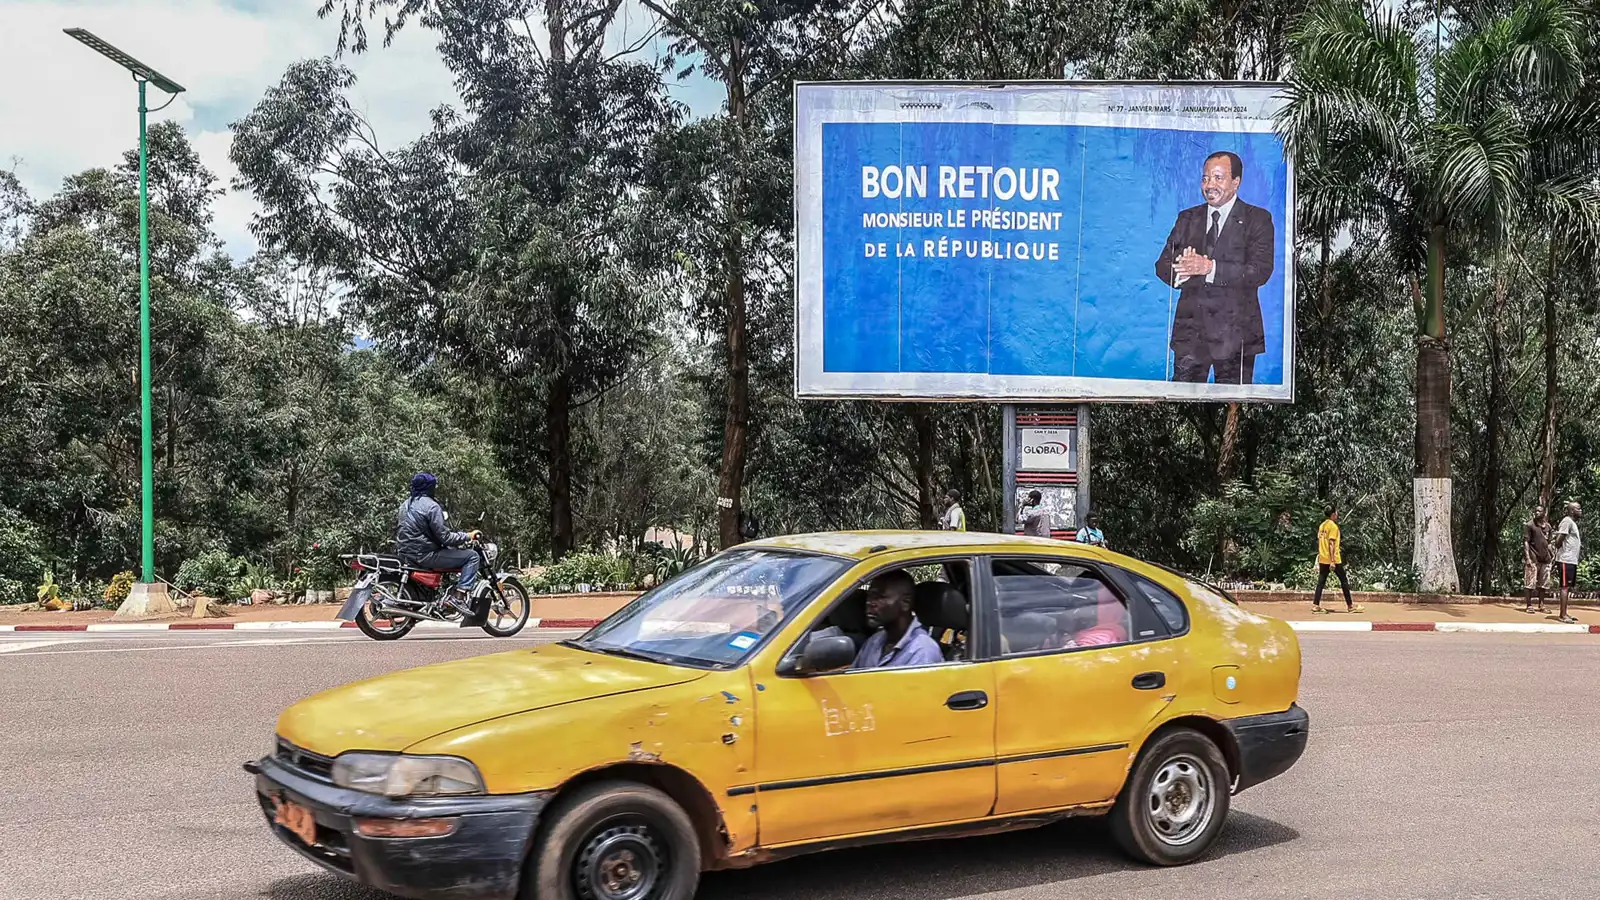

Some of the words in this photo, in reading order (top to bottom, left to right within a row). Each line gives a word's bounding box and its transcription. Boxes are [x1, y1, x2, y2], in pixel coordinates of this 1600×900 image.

[862, 165, 928, 199] BON
[939, 165, 1060, 201] RETOUR
[863, 212, 944, 228] MONSIEUR
[947, 209, 966, 228] LE
[971, 207, 1063, 231] PRÉSIDENT
[864, 243, 887, 258] DE
[896, 243, 916, 257] LA
[924, 236, 1059, 260] RÉPUBLIQUE
[1023, 445, 1060, 455] GLOBAL
